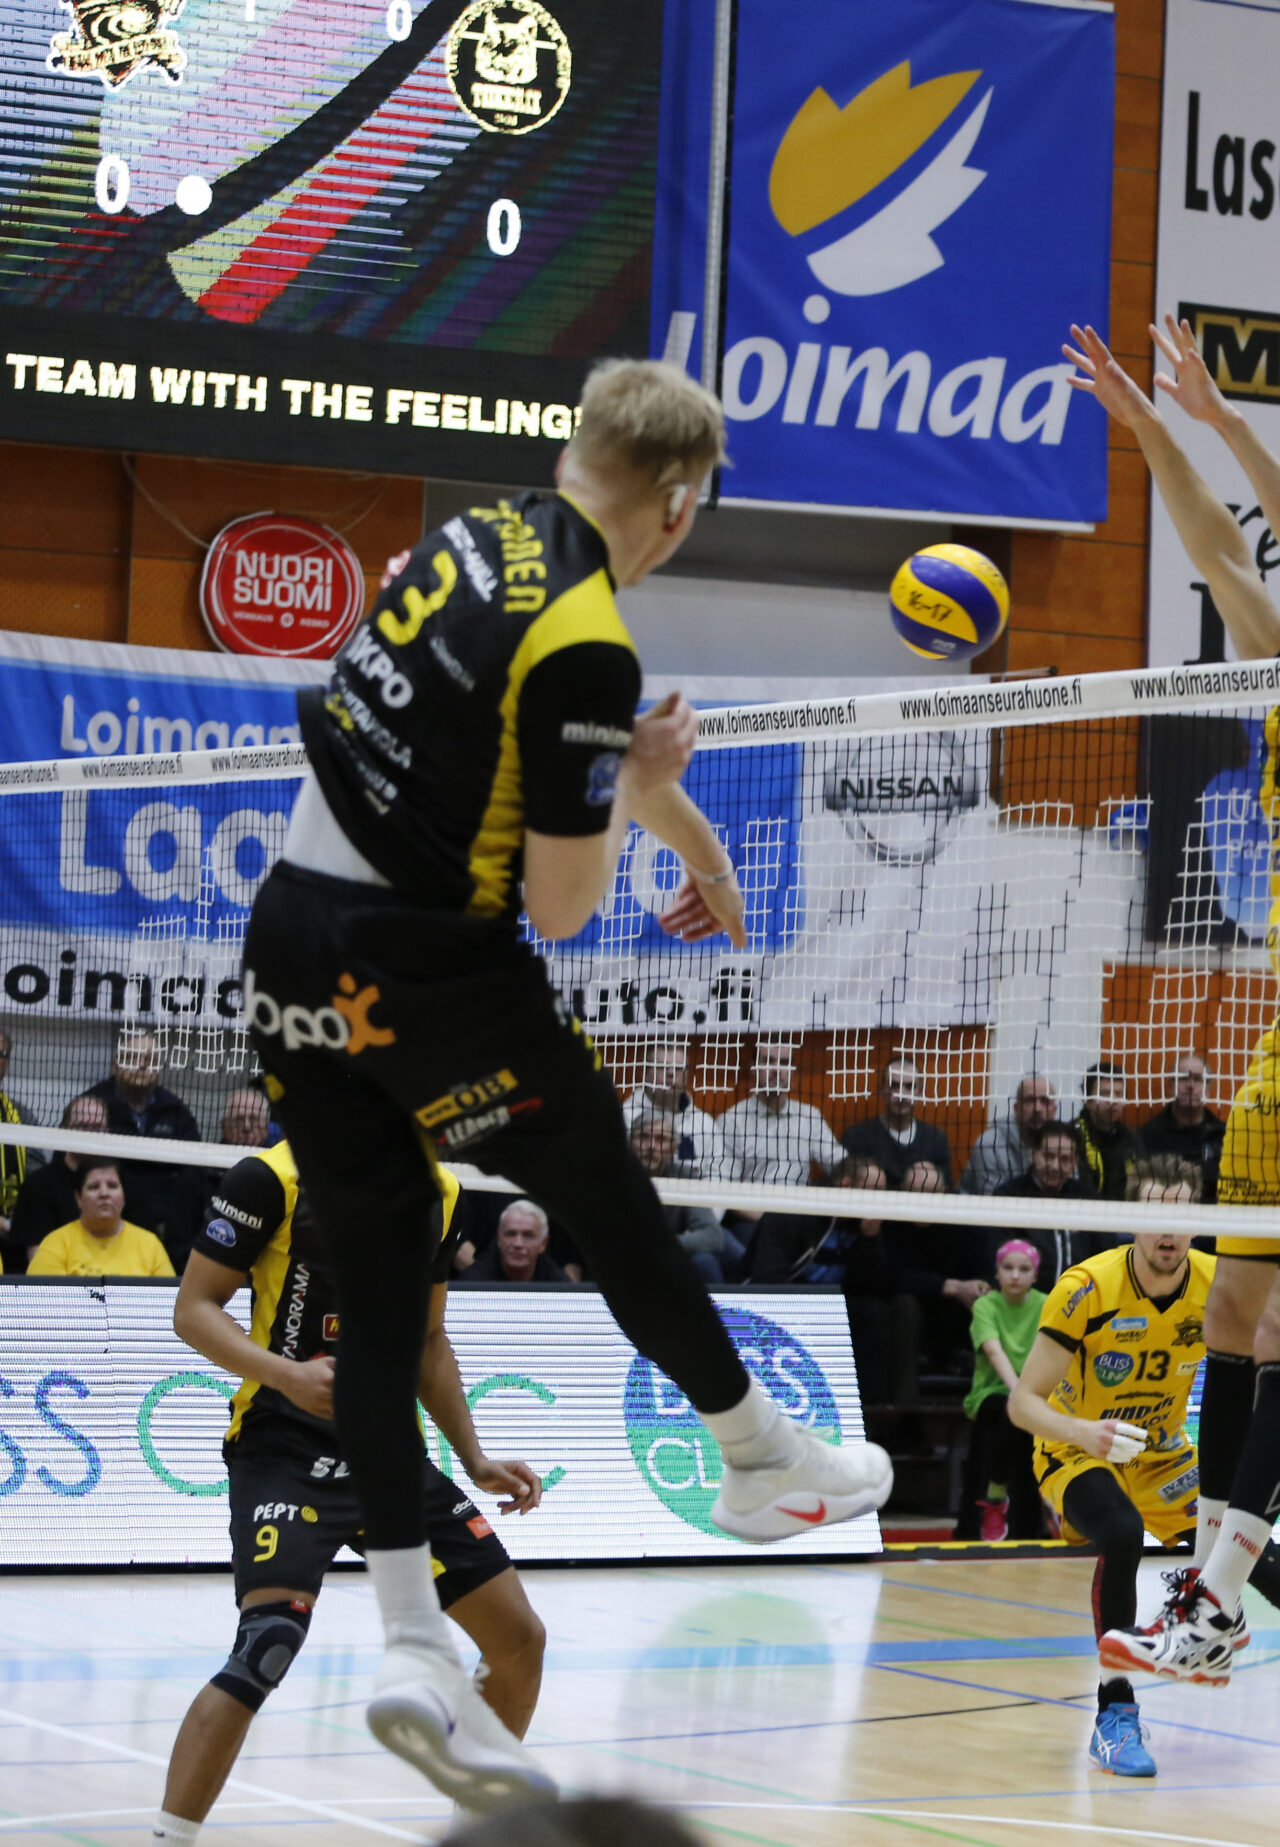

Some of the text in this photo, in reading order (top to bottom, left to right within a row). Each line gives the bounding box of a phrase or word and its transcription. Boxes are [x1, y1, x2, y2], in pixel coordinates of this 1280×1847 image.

[95, 154, 131, 214] 0
[486, 198, 522, 256] 0
[6, 352, 136, 400] TEAM
[149, 366, 268, 412] WITH
[281, 379, 374, 421] THE
[236, 549, 333, 584] NUORI
[233, 576, 333, 612] SUOMI
[377, 549, 457, 645] 3
[901, 678, 1083, 721] www.loimaanseurahuone.fi
[840, 774, 963, 801] NISSAN
[1135, 1350, 1171, 1381] 13
[253, 1524, 279, 1562] 9
